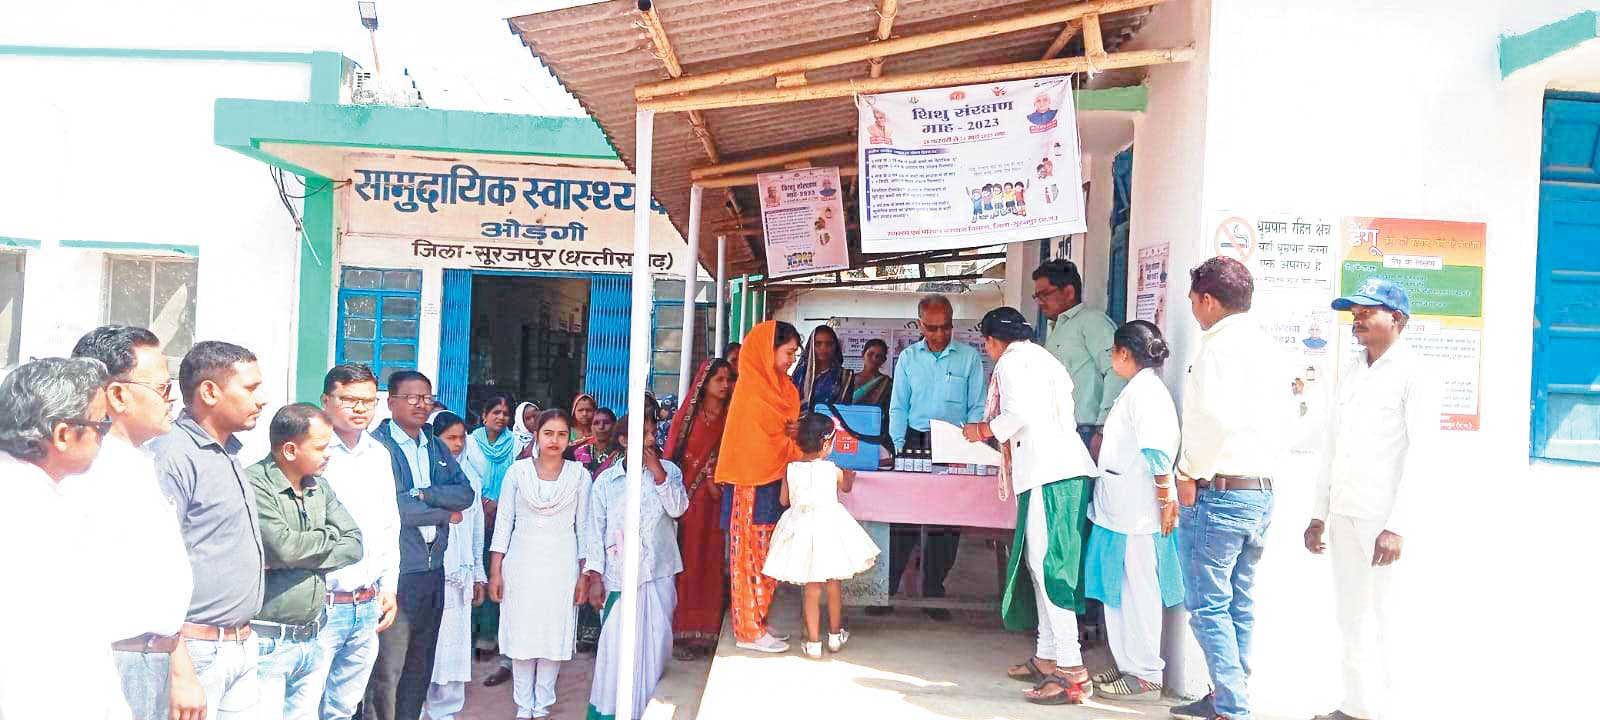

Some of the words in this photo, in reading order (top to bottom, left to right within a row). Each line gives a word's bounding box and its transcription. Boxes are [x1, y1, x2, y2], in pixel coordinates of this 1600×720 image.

[912, 107, 950, 122] शिशु
[953, 101, 1014, 118] संरक्षण
[921, 123, 954, 134] माह
[967, 118, 1000, 131] 2023
[354, 164, 520, 213] सामुदायिक
[1292, 217, 1312, 236] रहित
[1316, 217, 1331, 236] क्षेत्र
[1307, 244, 1329, 255] करना
[1260, 259, 1275, 270] एक
[1281, 260, 1311, 272] अपराध
